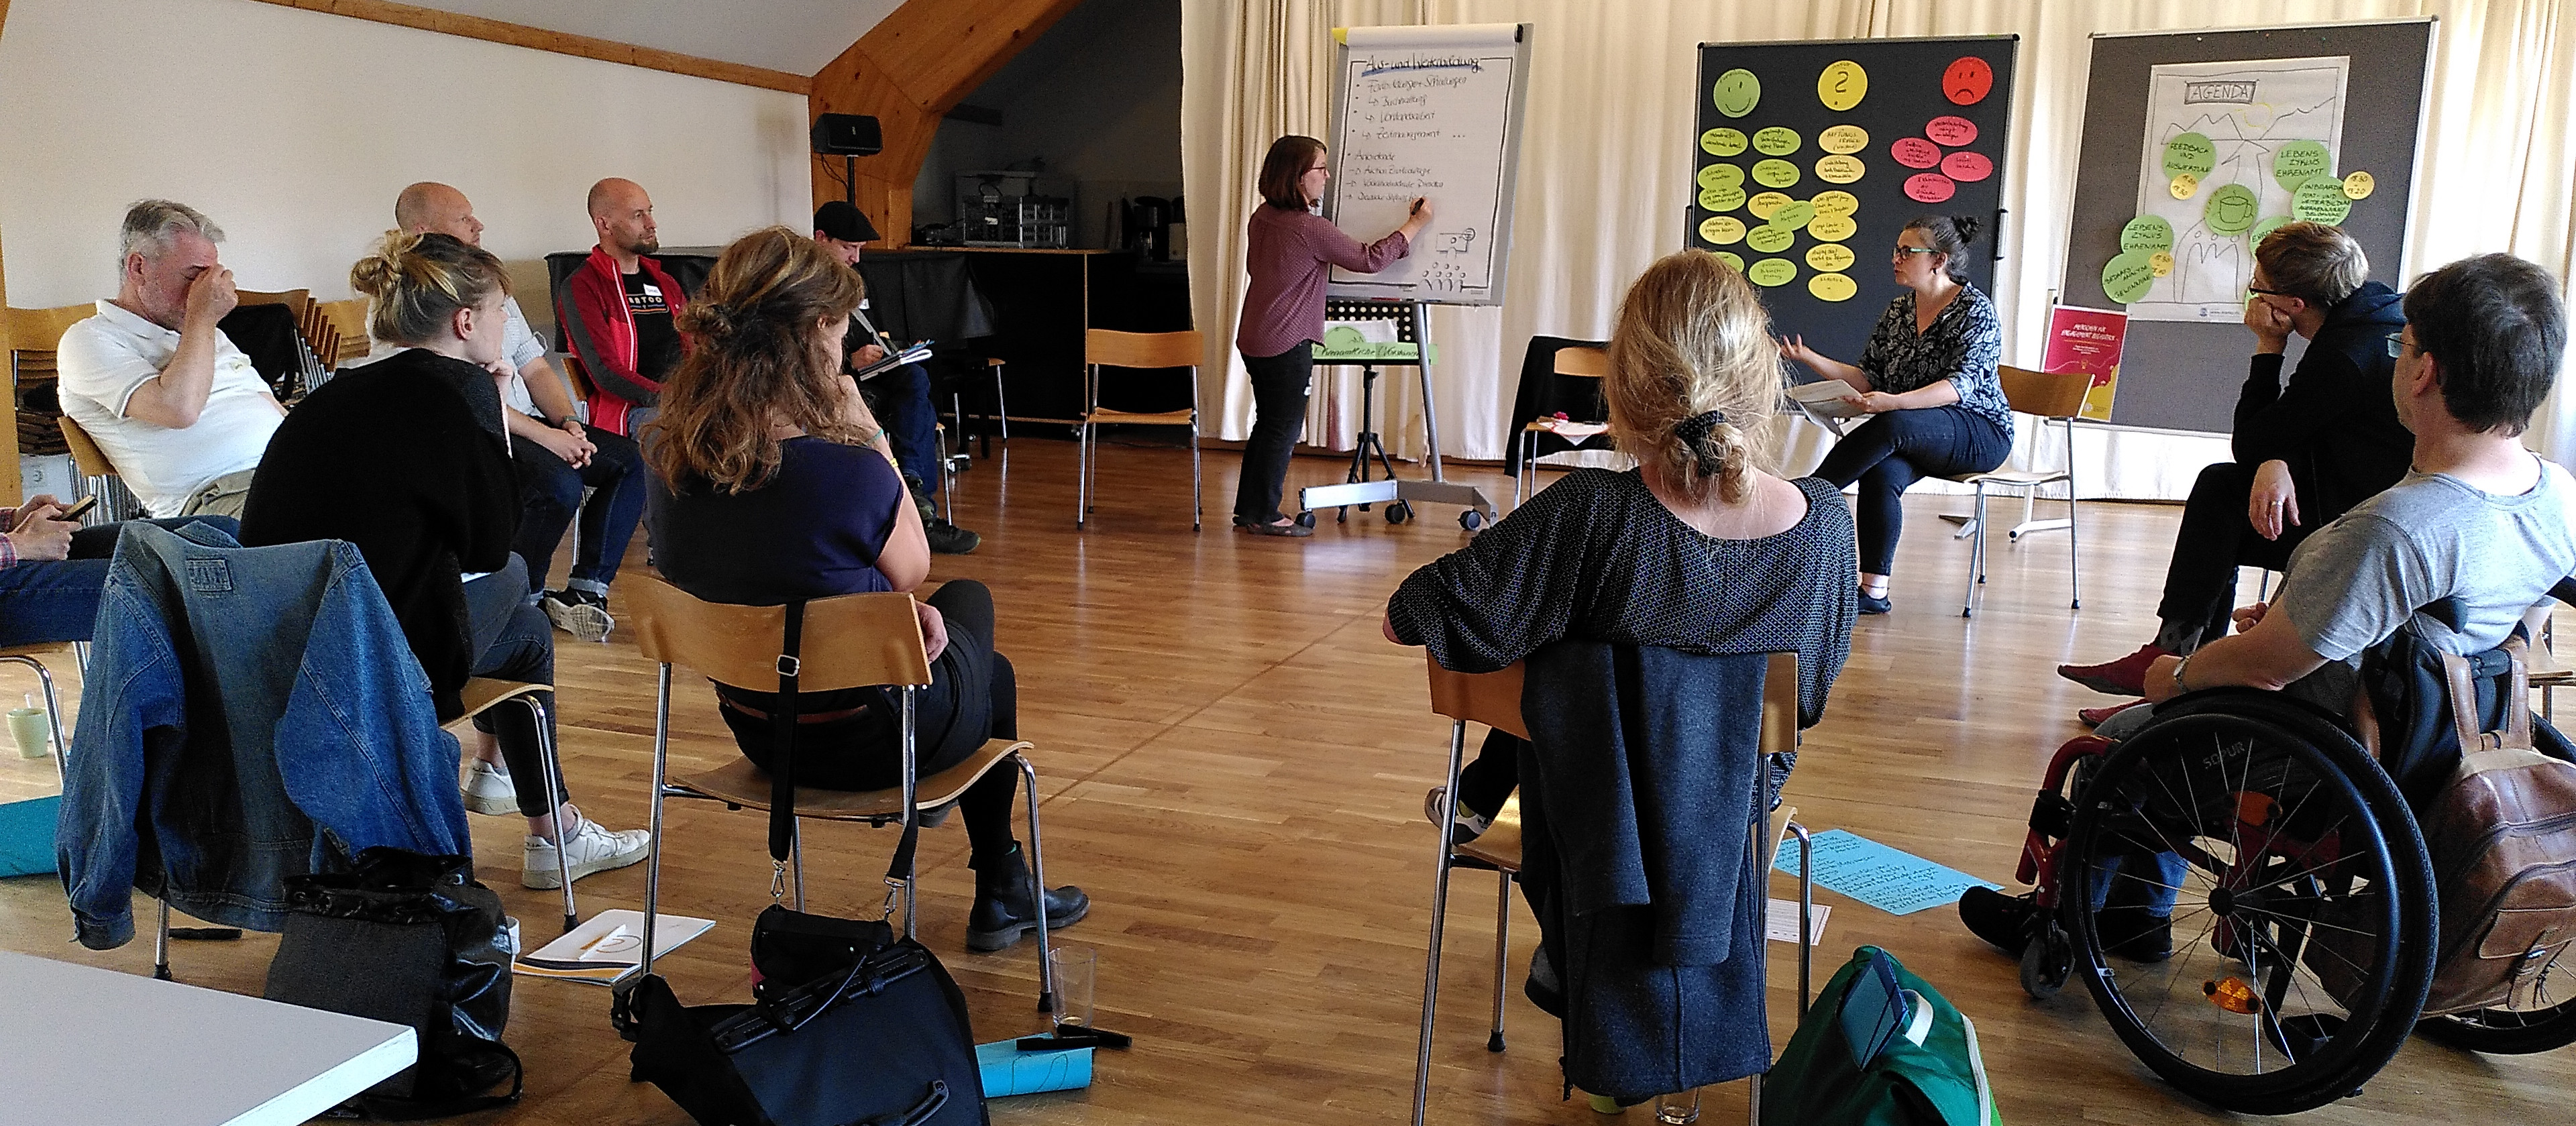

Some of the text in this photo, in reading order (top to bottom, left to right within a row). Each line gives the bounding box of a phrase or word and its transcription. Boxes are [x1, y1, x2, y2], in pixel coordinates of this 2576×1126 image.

[2191, 85, 2249, 100] AGENDA
[2170, 143, 2209, 154] FEEDBACK
[2275, 168, 2324, 178] EHRENAMT
[2123, 243, 2169, 251] EHRENAMT
